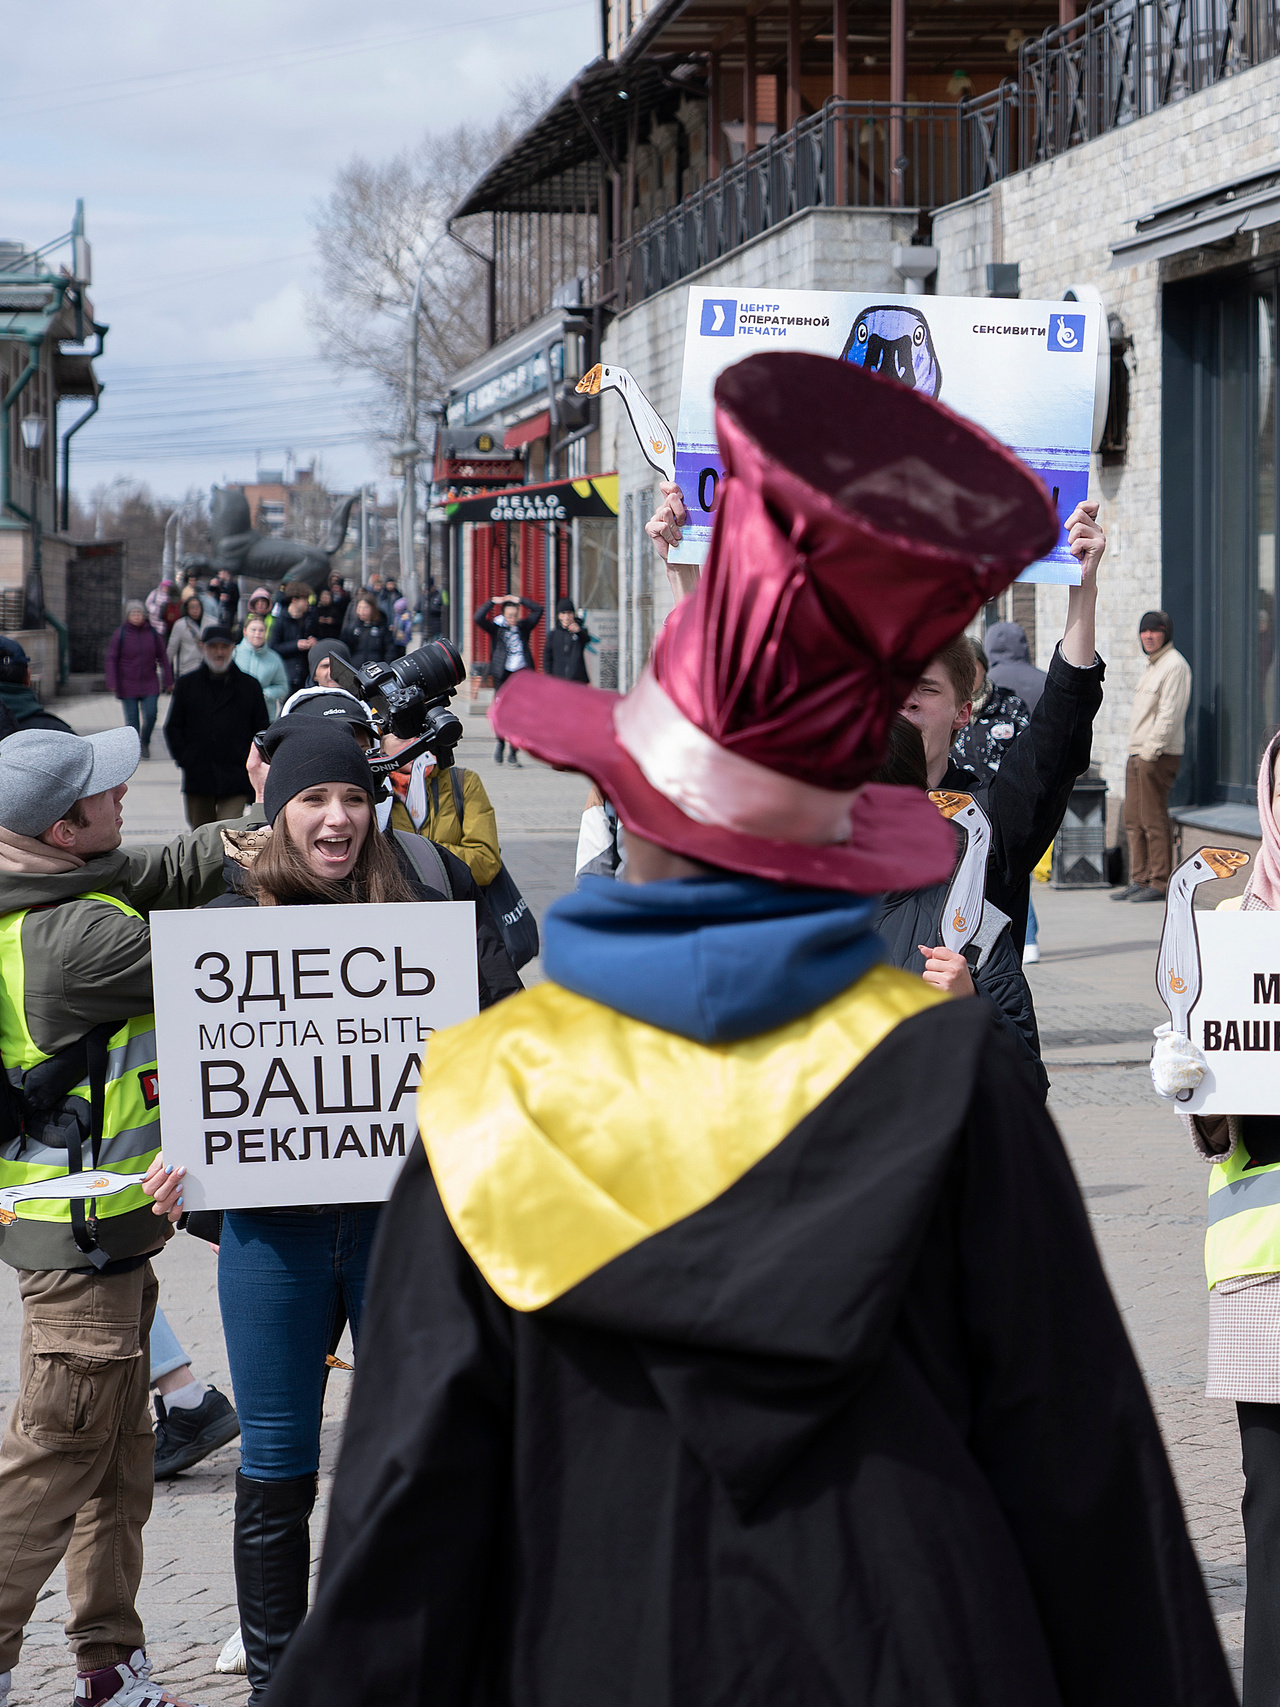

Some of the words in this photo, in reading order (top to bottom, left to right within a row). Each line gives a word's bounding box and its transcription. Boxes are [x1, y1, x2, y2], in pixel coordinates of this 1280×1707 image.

[740, 303, 780, 313] ЦЕНТР
[739, 314, 830, 327] ОПЕРАТИВНОЙ
[738, 326, 787, 336] ПЕЧАТИ
[972, 324, 1046, 337] СЕНСИВИТИ
[496, 494, 560, 508] HELLO
[490, 506, 567, 521] ORGANIC
[323, 708, 346, 716] adidas
[369, 760, 400, 773] ONIN
[194, 946, 436, 1013] ЗДЕСЬ
[199, 1019, 324, 1050] МОГЛА
[336, 1016, 436, 1045] БЫТЬ
[200, 1052, 424, 1120] ВАША
[204, 1123, 406, 1165] РЕКЛАМ
